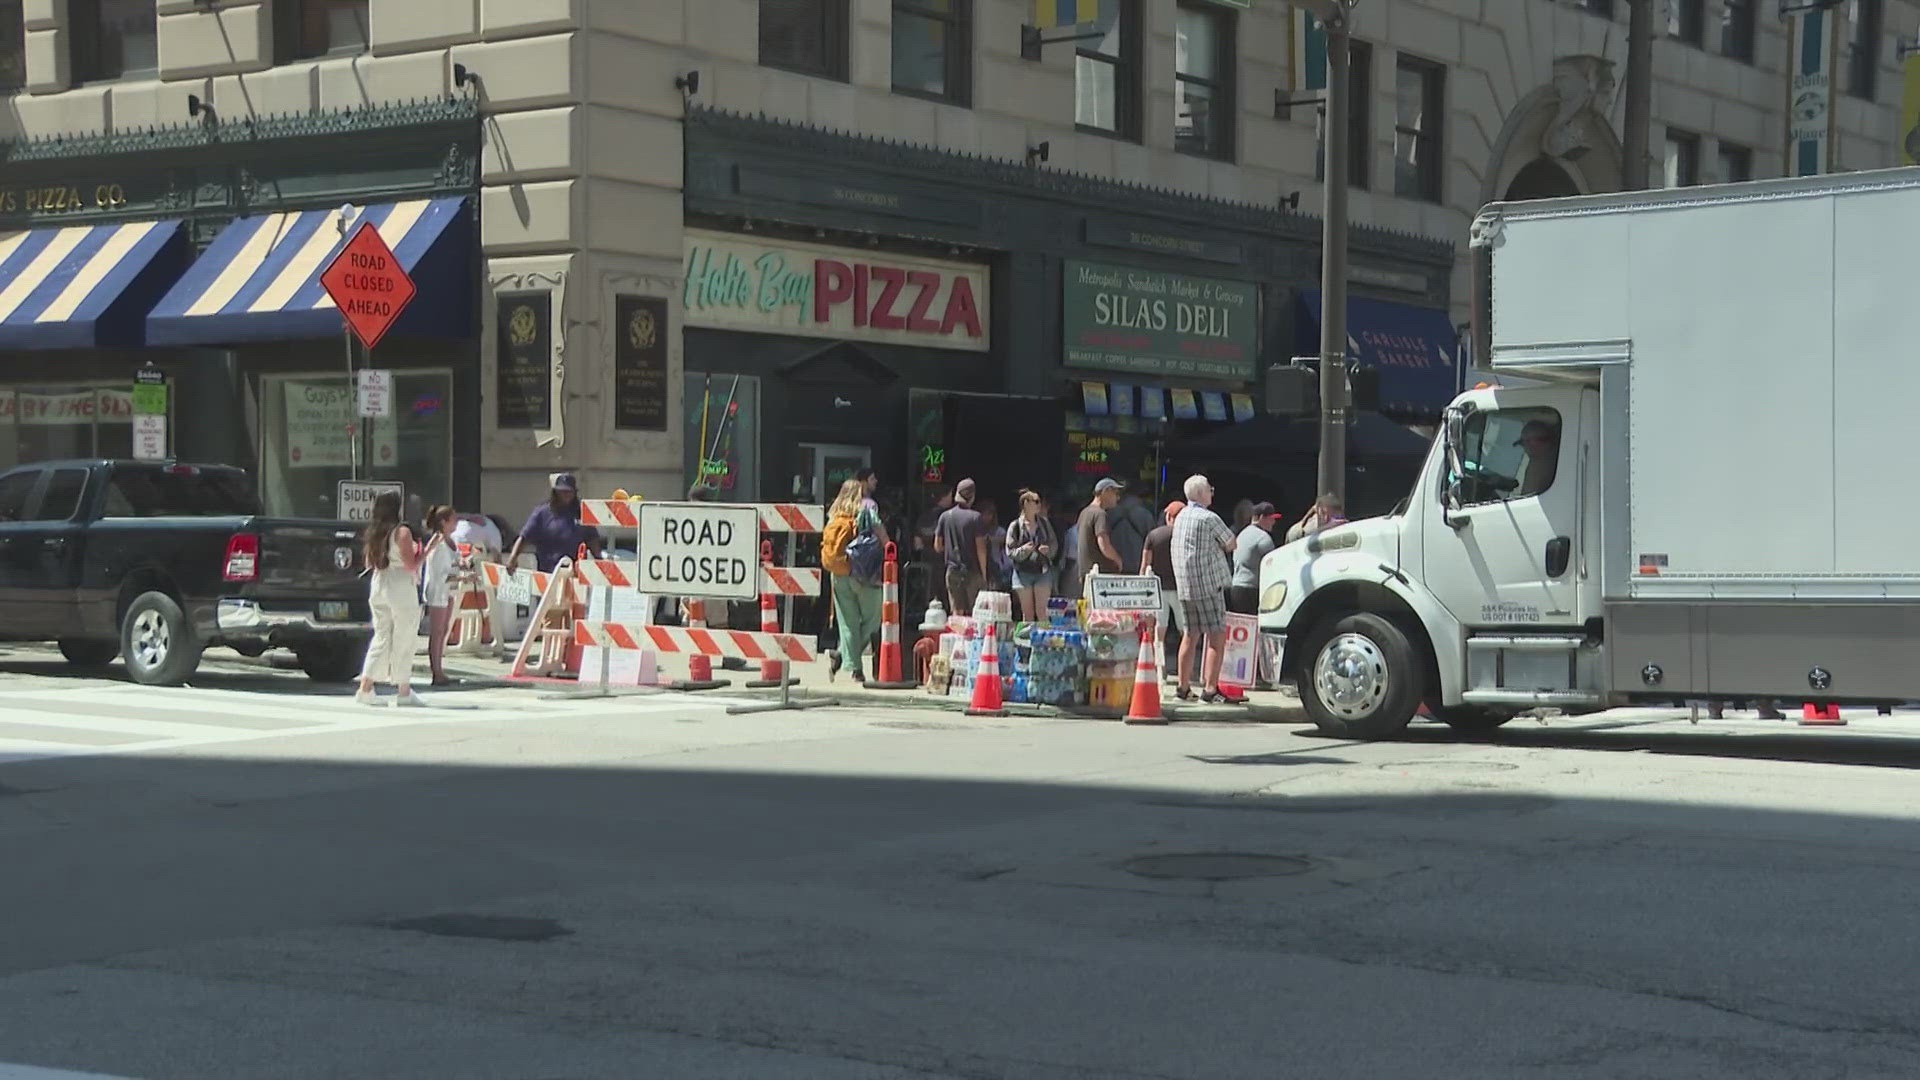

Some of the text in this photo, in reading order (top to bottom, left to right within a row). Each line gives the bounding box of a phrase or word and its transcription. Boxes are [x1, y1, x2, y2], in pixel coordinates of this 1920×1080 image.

[25, 187, 82, 211] PIZZA
[95, 183, 127, 206] CO.
[350, 252, 386, 271] ROAD
[343, 273, 394, 292] CLOSED
[1078, 266, 1244, 307] Metropolis Sandwich Market & Grocery
[754, 250, 812, 325] Bay
[814, 258, 983, 338] PIZZA
[346, 298, 391, 316] AHEAD
[1094, 292, 1229, 338] SILAS DELI
[1362, 330, 1428, 352] CARLISLE
[1376, 349, 1431, 368] BAKERY
[368, 375, 381, 384] NO
[23, 398, 50, 416] BY
[57, 397, 95, 416] THE
[304, 387, 337, 407] Guys
[663, 518, 733, 546] ROAD
[648, 554, 747, 585] CLOSED
[1095, 580, 1156, 589] SIDEWALK CLOSED
[1481, 613, 1492, 621] US
[1493, 613, 1506, 621] DOT
